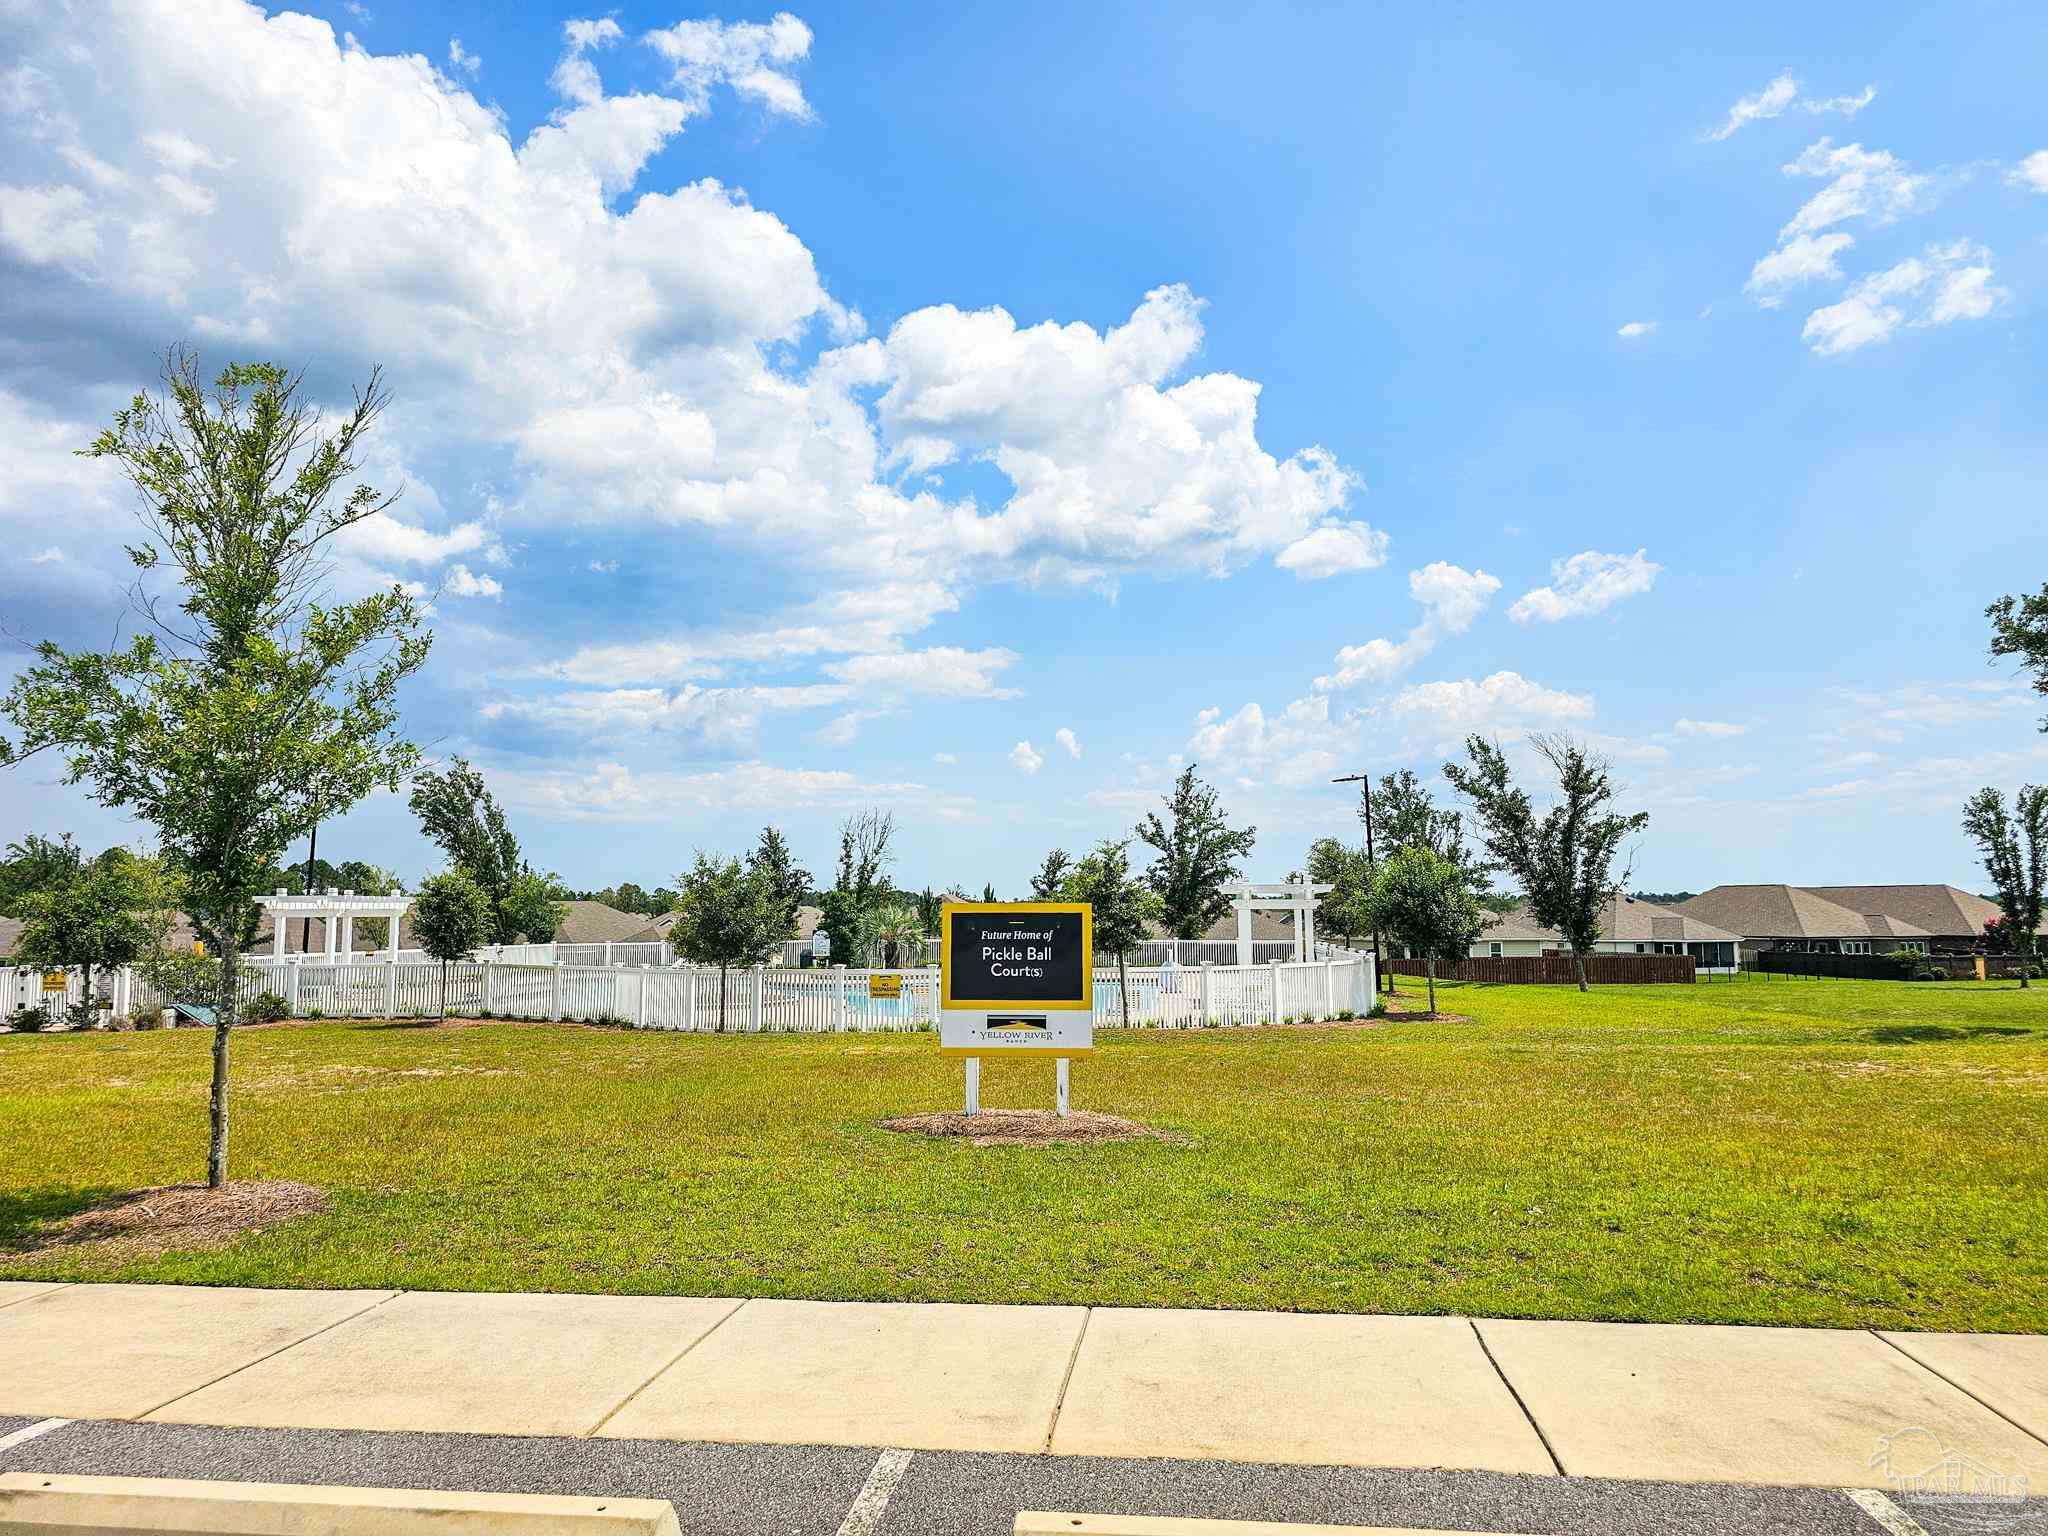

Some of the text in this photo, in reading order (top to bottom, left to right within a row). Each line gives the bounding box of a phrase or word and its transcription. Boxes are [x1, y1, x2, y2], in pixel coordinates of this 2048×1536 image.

[981, 929, 1054, 942] Future Home of
[982, 946, 1052, 961] Pickle Ball
[990, 962, 1044, 977] Court(s)
[979, 1031, 1053, 1041] YELLOW RIVER
